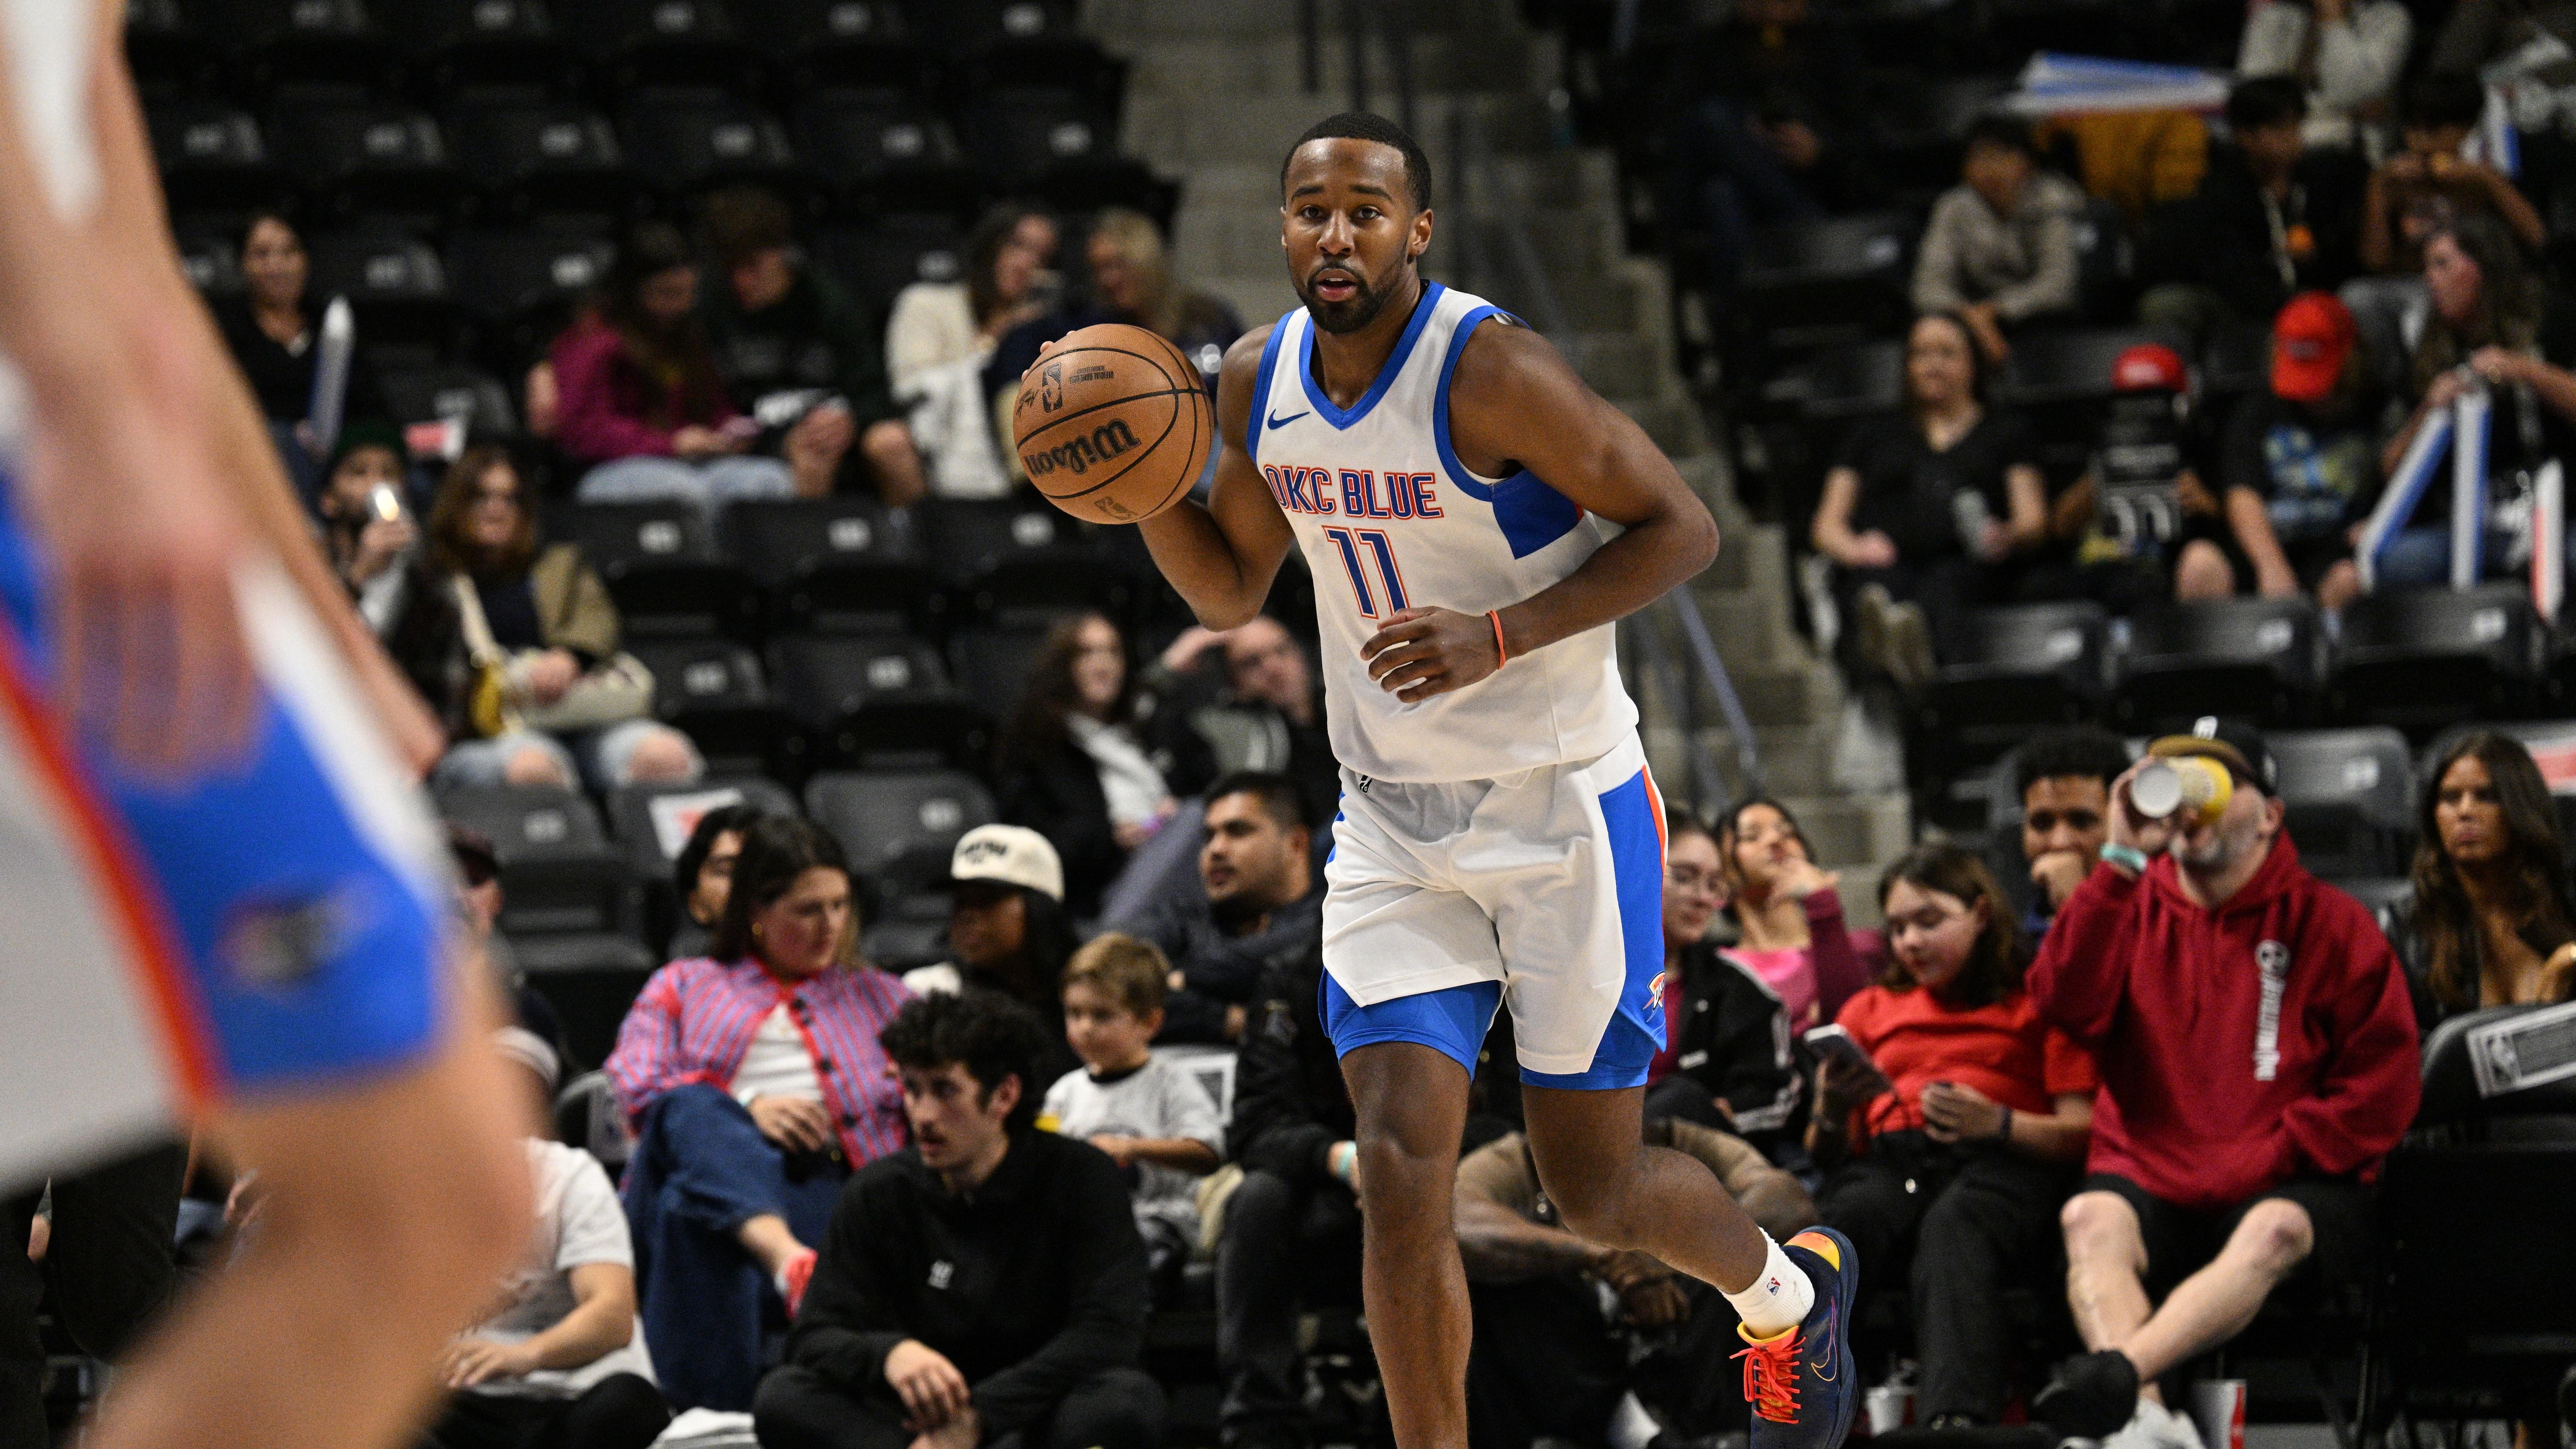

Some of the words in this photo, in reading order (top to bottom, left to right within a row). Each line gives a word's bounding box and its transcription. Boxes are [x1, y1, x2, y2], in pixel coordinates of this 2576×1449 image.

[1093, 371, 1114, 380] OFFICIAL
[1024, 418, 1141, 478] Wilson
[1263, 464, 1336, 515] OKC
[1338, 468, 1444, 520] BLUE
[1321, 525, 1410, 619] 11
